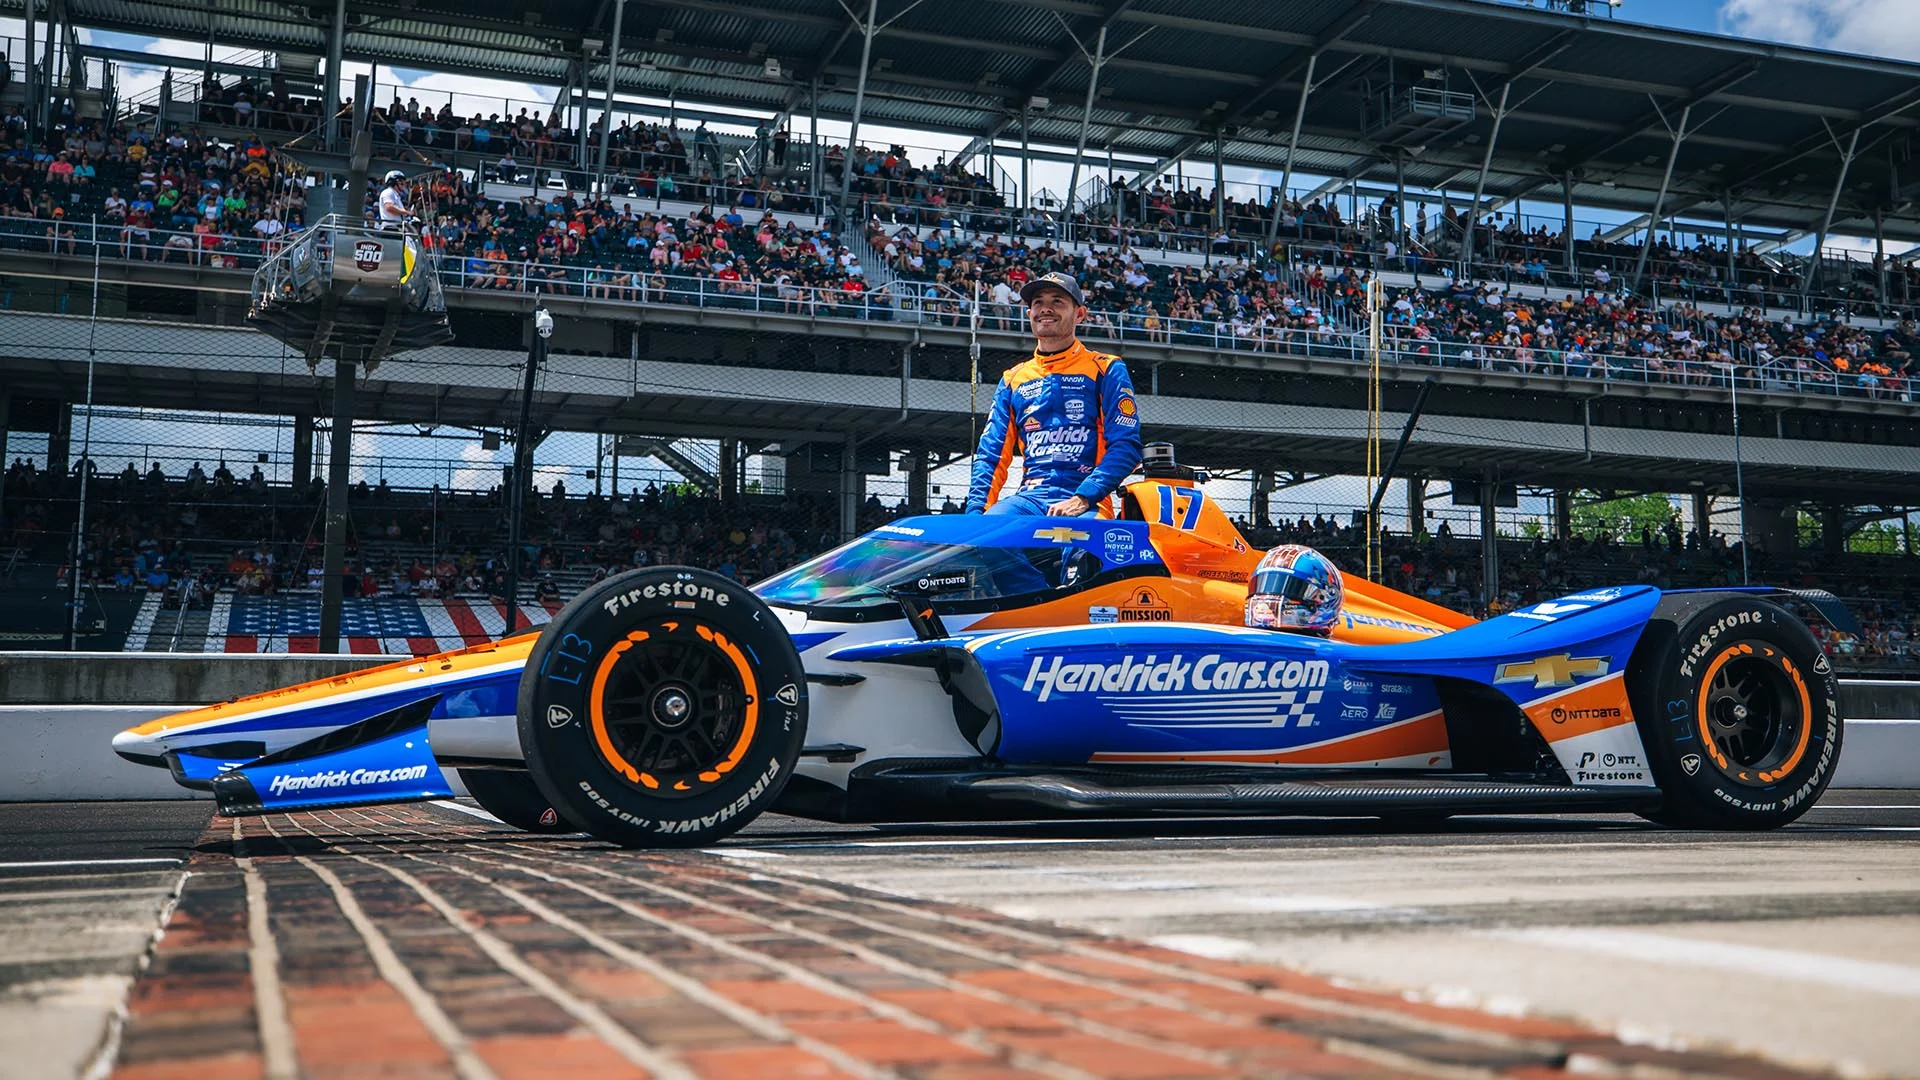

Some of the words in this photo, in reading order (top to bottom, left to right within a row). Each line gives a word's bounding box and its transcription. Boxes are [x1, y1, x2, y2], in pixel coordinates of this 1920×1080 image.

[354, 250, 382, 262] 500
[1026, 426, 1090, 445] Hendrick
[1157, 485, 1204, 532] 17
[1139, 549, 1154, 560] PPG
[604, 580, 730, 617] Firestone
[1679, 610, 1763, 678] Firestone
[1340, 709, 1369, 719] AERO
[1617, 755, 1636, 765] NTT
[1782, 698, 1837, 811] FIREHAWK
[1577, 770, 1643, 782] Firestone
[653, 757, 781, 834] FIREHAWK
